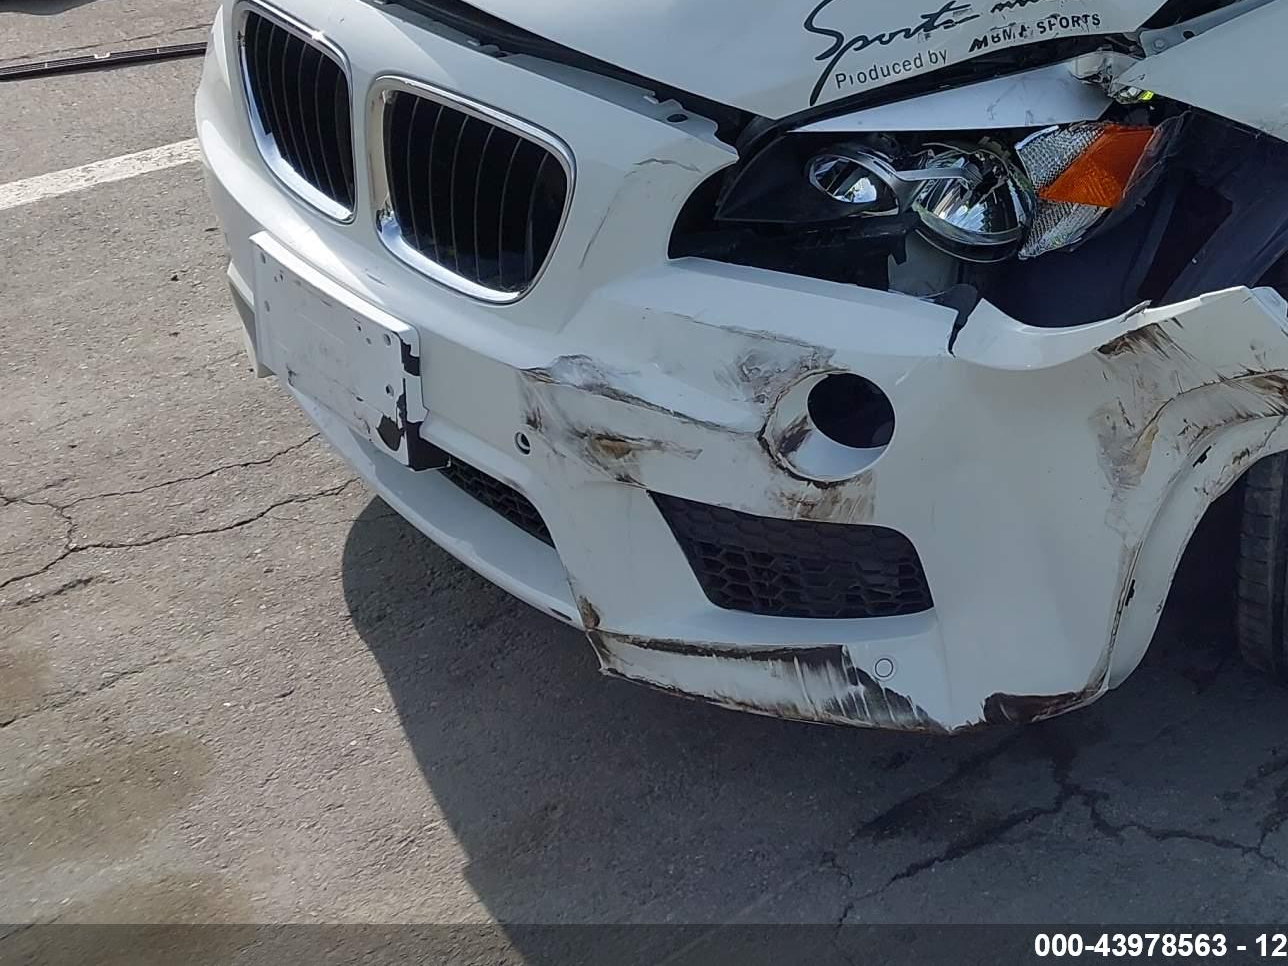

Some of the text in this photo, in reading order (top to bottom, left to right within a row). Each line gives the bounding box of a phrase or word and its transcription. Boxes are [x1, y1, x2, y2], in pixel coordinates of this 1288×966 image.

[1036, 12, 1101, 35] SPORTS
[835, 48, 947, 90] Produced by
